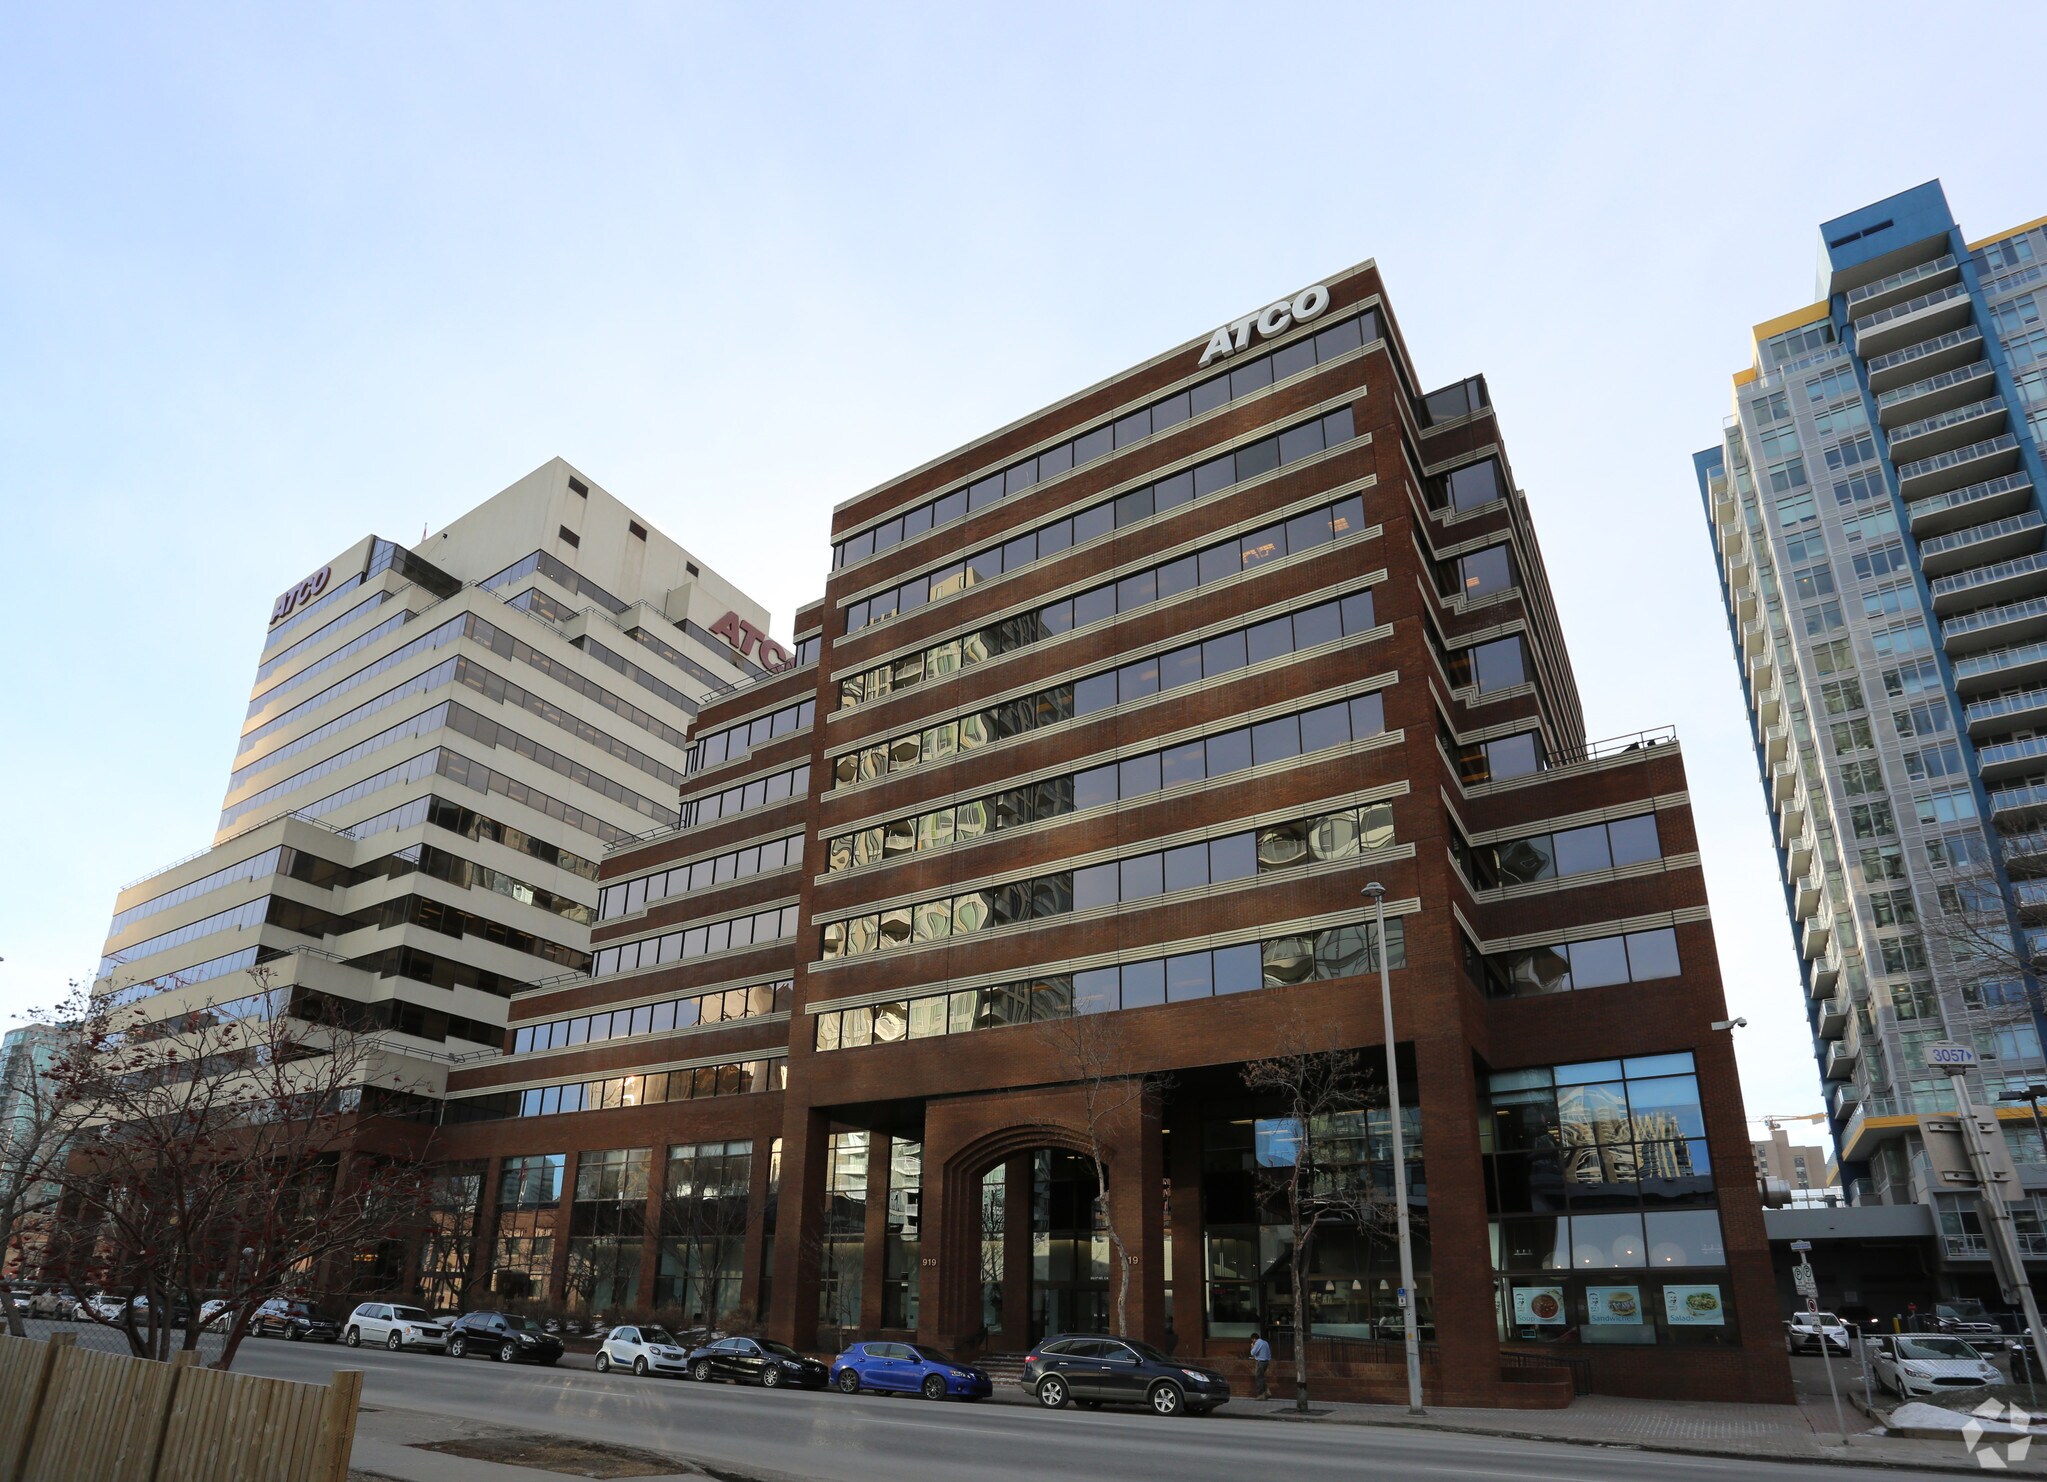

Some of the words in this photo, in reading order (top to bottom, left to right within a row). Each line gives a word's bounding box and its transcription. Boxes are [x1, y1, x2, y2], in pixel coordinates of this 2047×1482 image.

[1198, 285, 1330, 368] ATCO
[269, 565, 331, 625] ATCO
[708, 611, 796, 674] ATC
[1933, 1049, 1965, 1061] 3057
[922, 1258, 936, 1266] 919
[1126, 1256, 1139, 1265] 19
[1670, 1314, 1695, 1322] Salads
